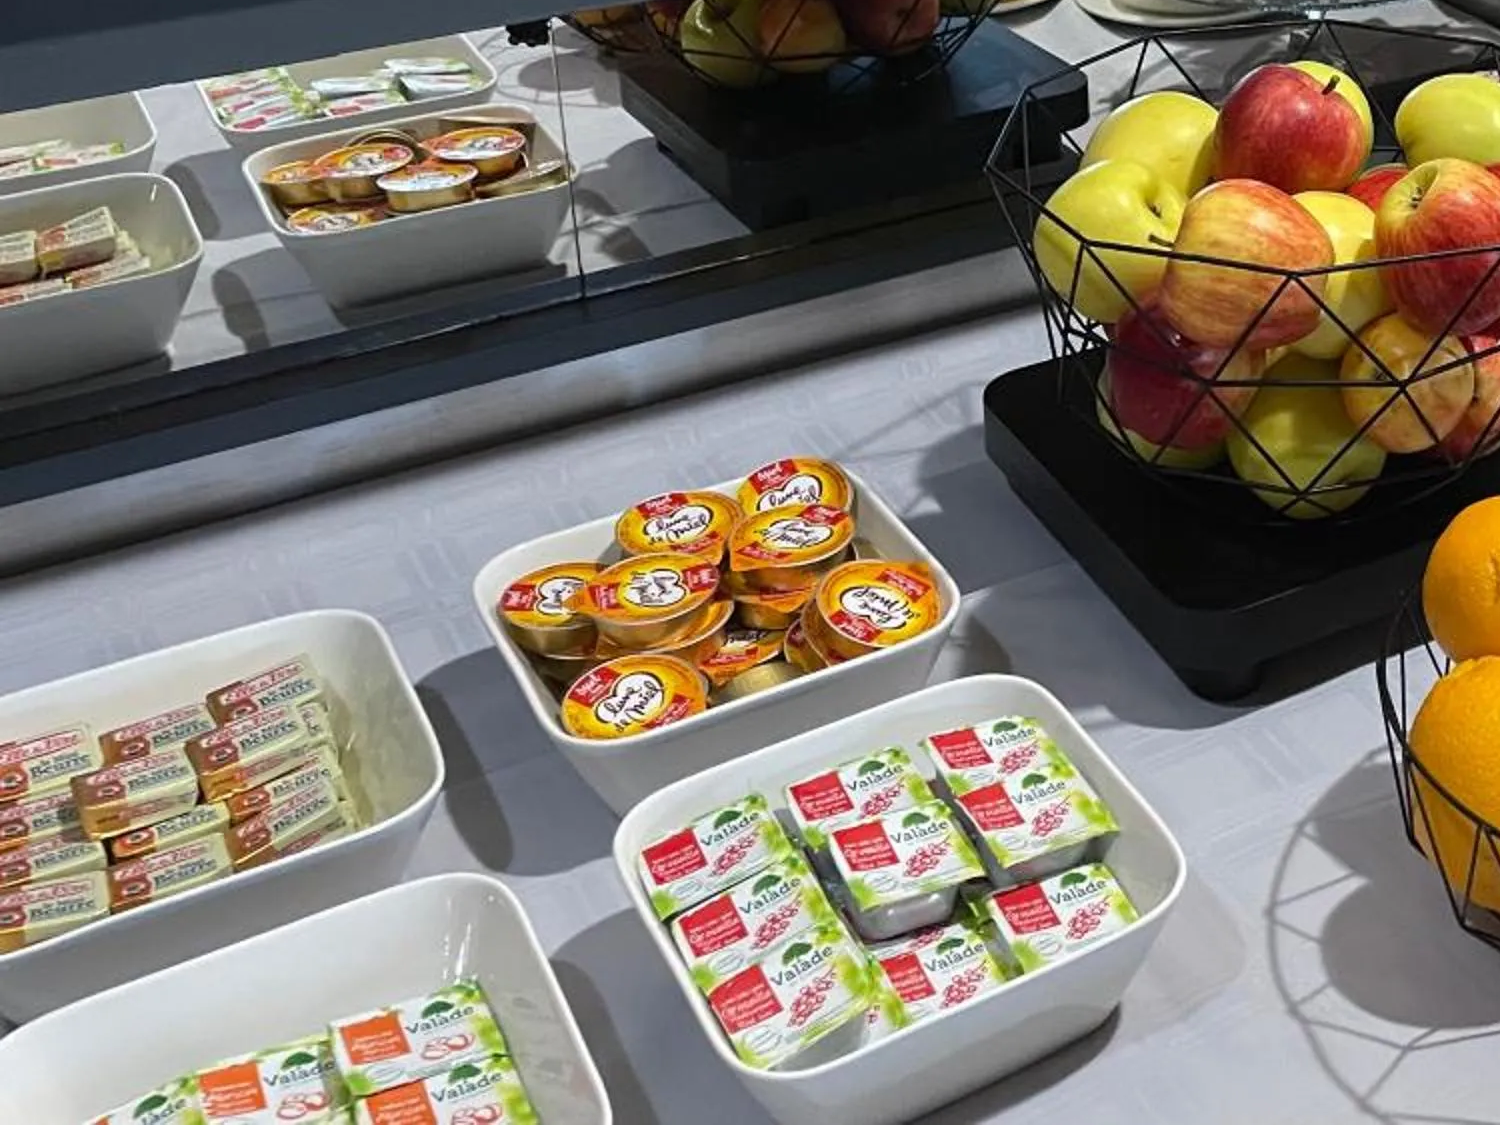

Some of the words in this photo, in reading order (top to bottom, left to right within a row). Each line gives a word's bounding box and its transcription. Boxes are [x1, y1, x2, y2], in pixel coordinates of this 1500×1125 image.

[983, 727, 1037, 748] Valade
[847, 764, 904, 792] Valade
[1011, 781, 1067, 805] Valade
[701, 812, 760, 847] Valade
[890, 820, 949, 844] Valade
[740, 878, 801, 915] Valade
[1050, 878, 1107, 905] Valade
[770, 945, 834, 987] Valade
[924, 941, 987, 973] Valade
[406, 1005, 474, 1035] Valade
[264, 1060, 336, 1088] Valade
[431, 1073, 502, 1103] Valade
